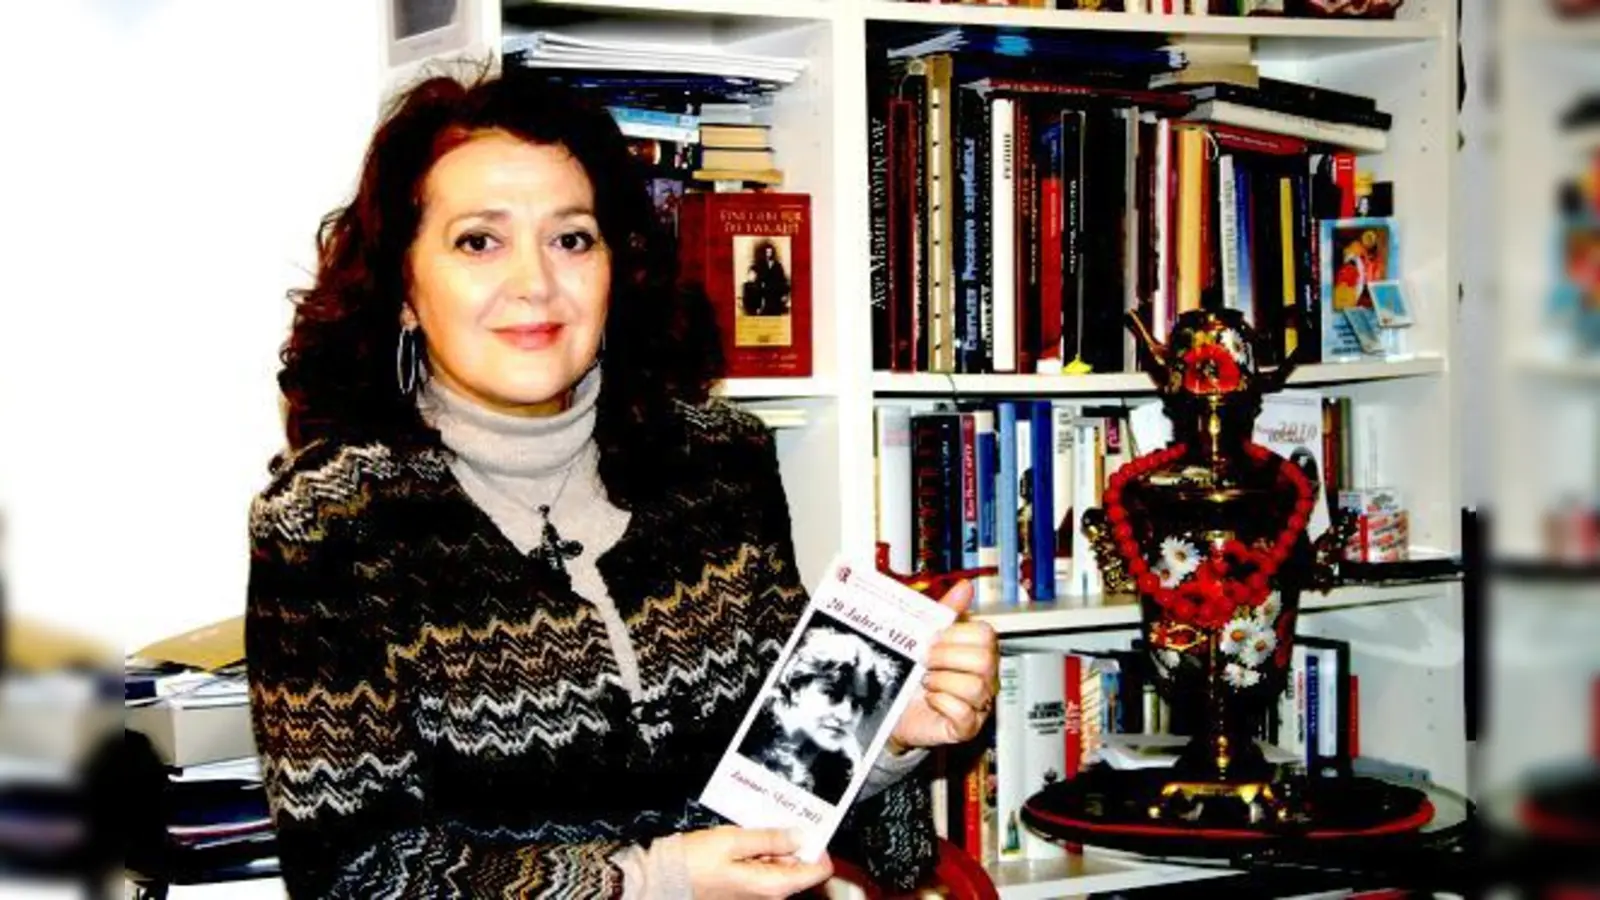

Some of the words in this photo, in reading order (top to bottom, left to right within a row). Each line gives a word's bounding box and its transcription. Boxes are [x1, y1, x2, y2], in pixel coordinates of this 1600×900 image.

[826, 597, 845, 611] 20
[843, 606, 884, 633] Jahre
[888, 628, 918, 652] MIR
